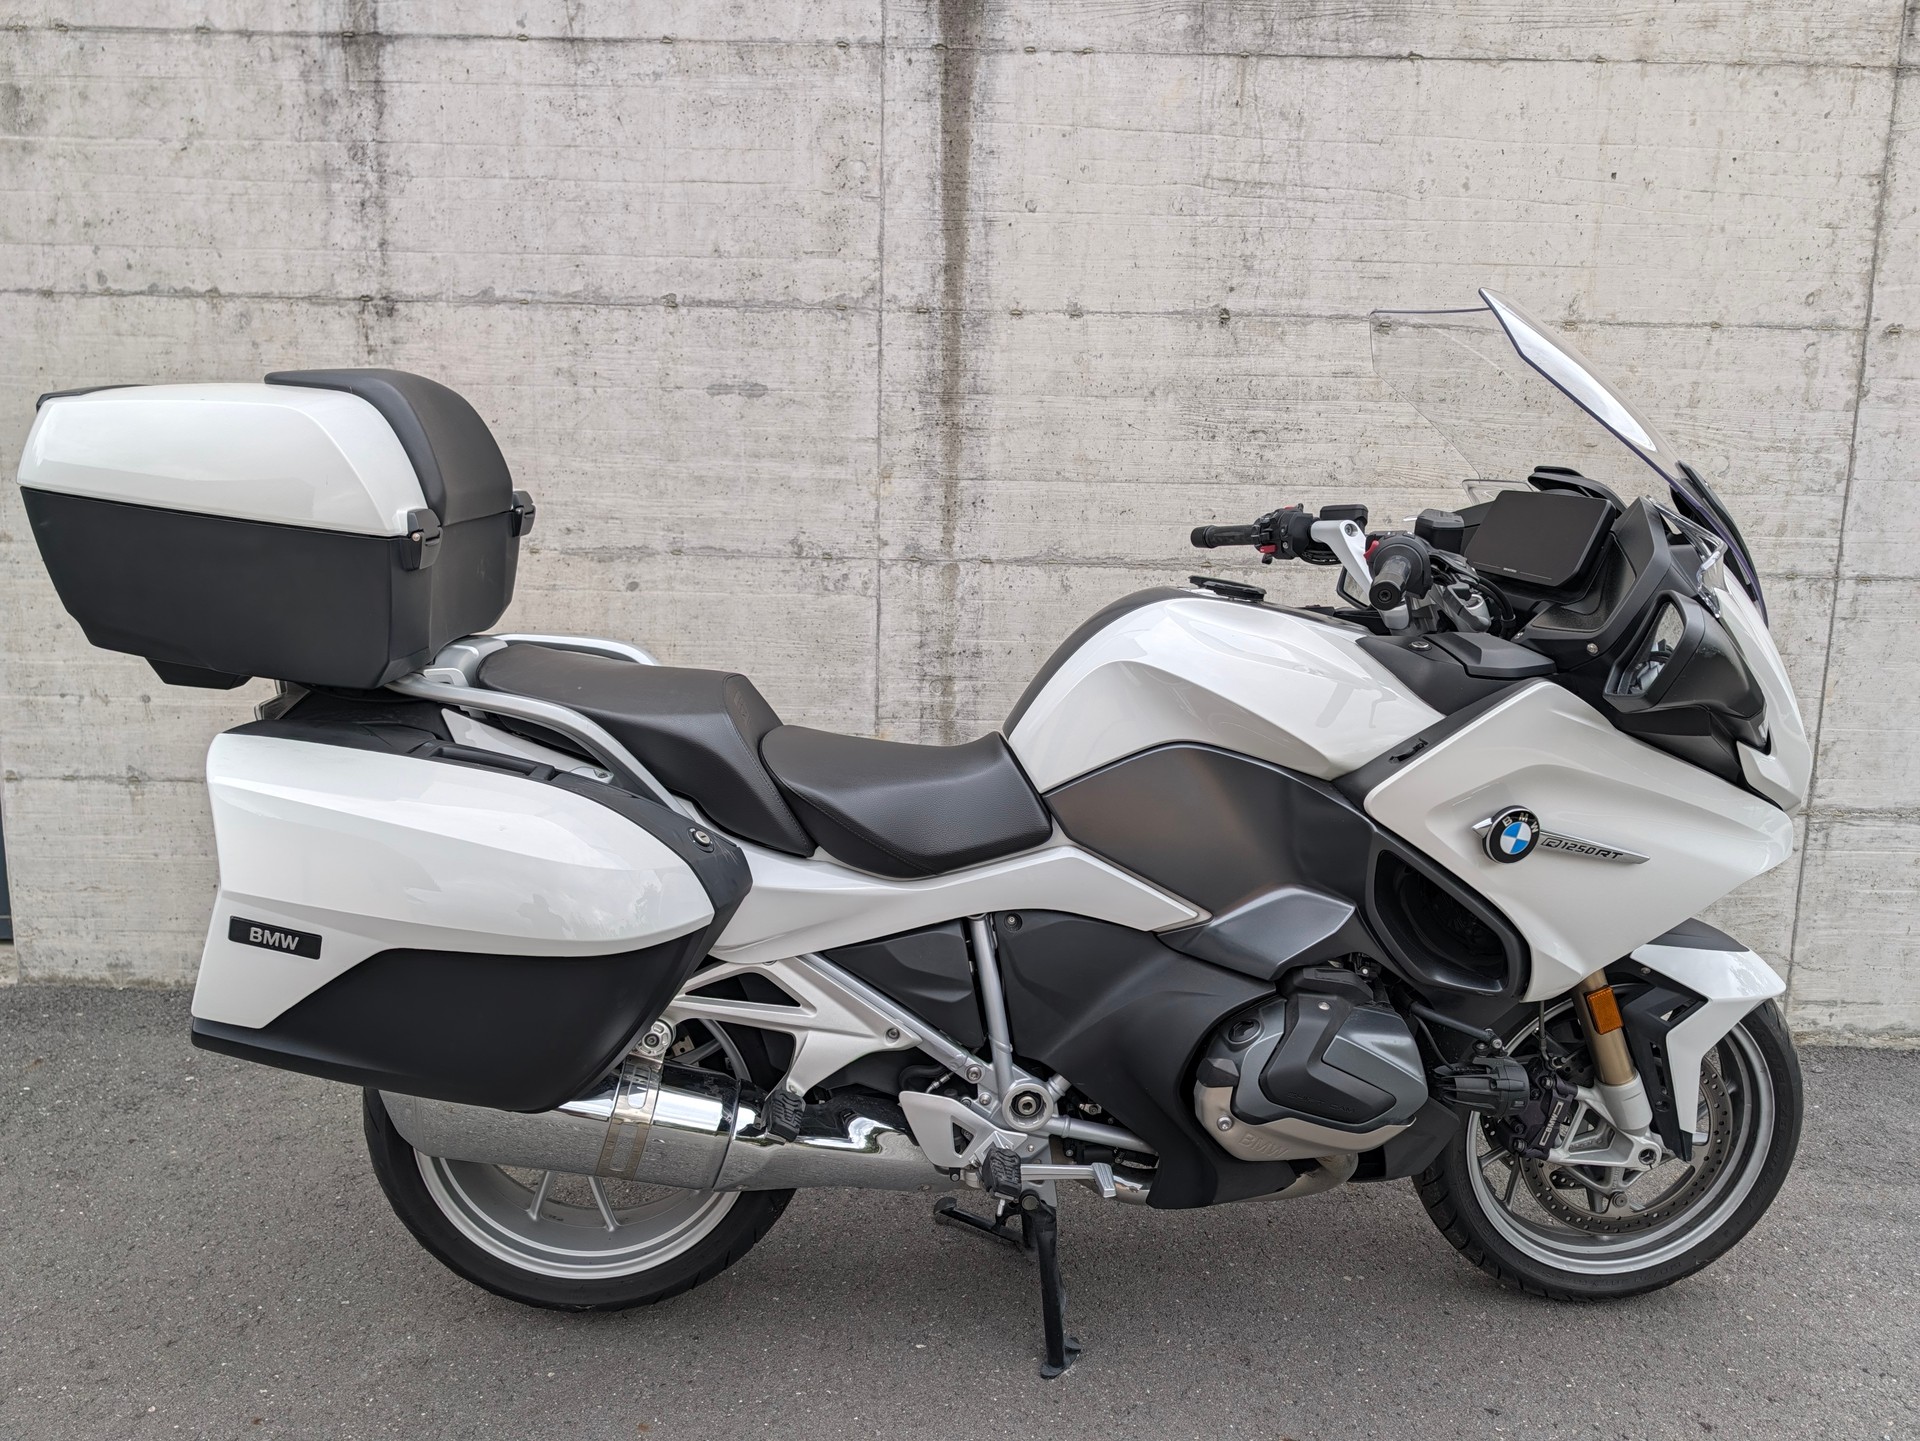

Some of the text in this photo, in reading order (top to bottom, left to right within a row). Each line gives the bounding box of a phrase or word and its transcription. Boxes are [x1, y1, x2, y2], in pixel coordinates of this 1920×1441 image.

[1502, 813, 1539, 834] BMW
[249, 926, 299, 951] BMW
[1545, 1112, 1559, 1133] BMW
[1238, 1132, 1289, 1159] BMW
